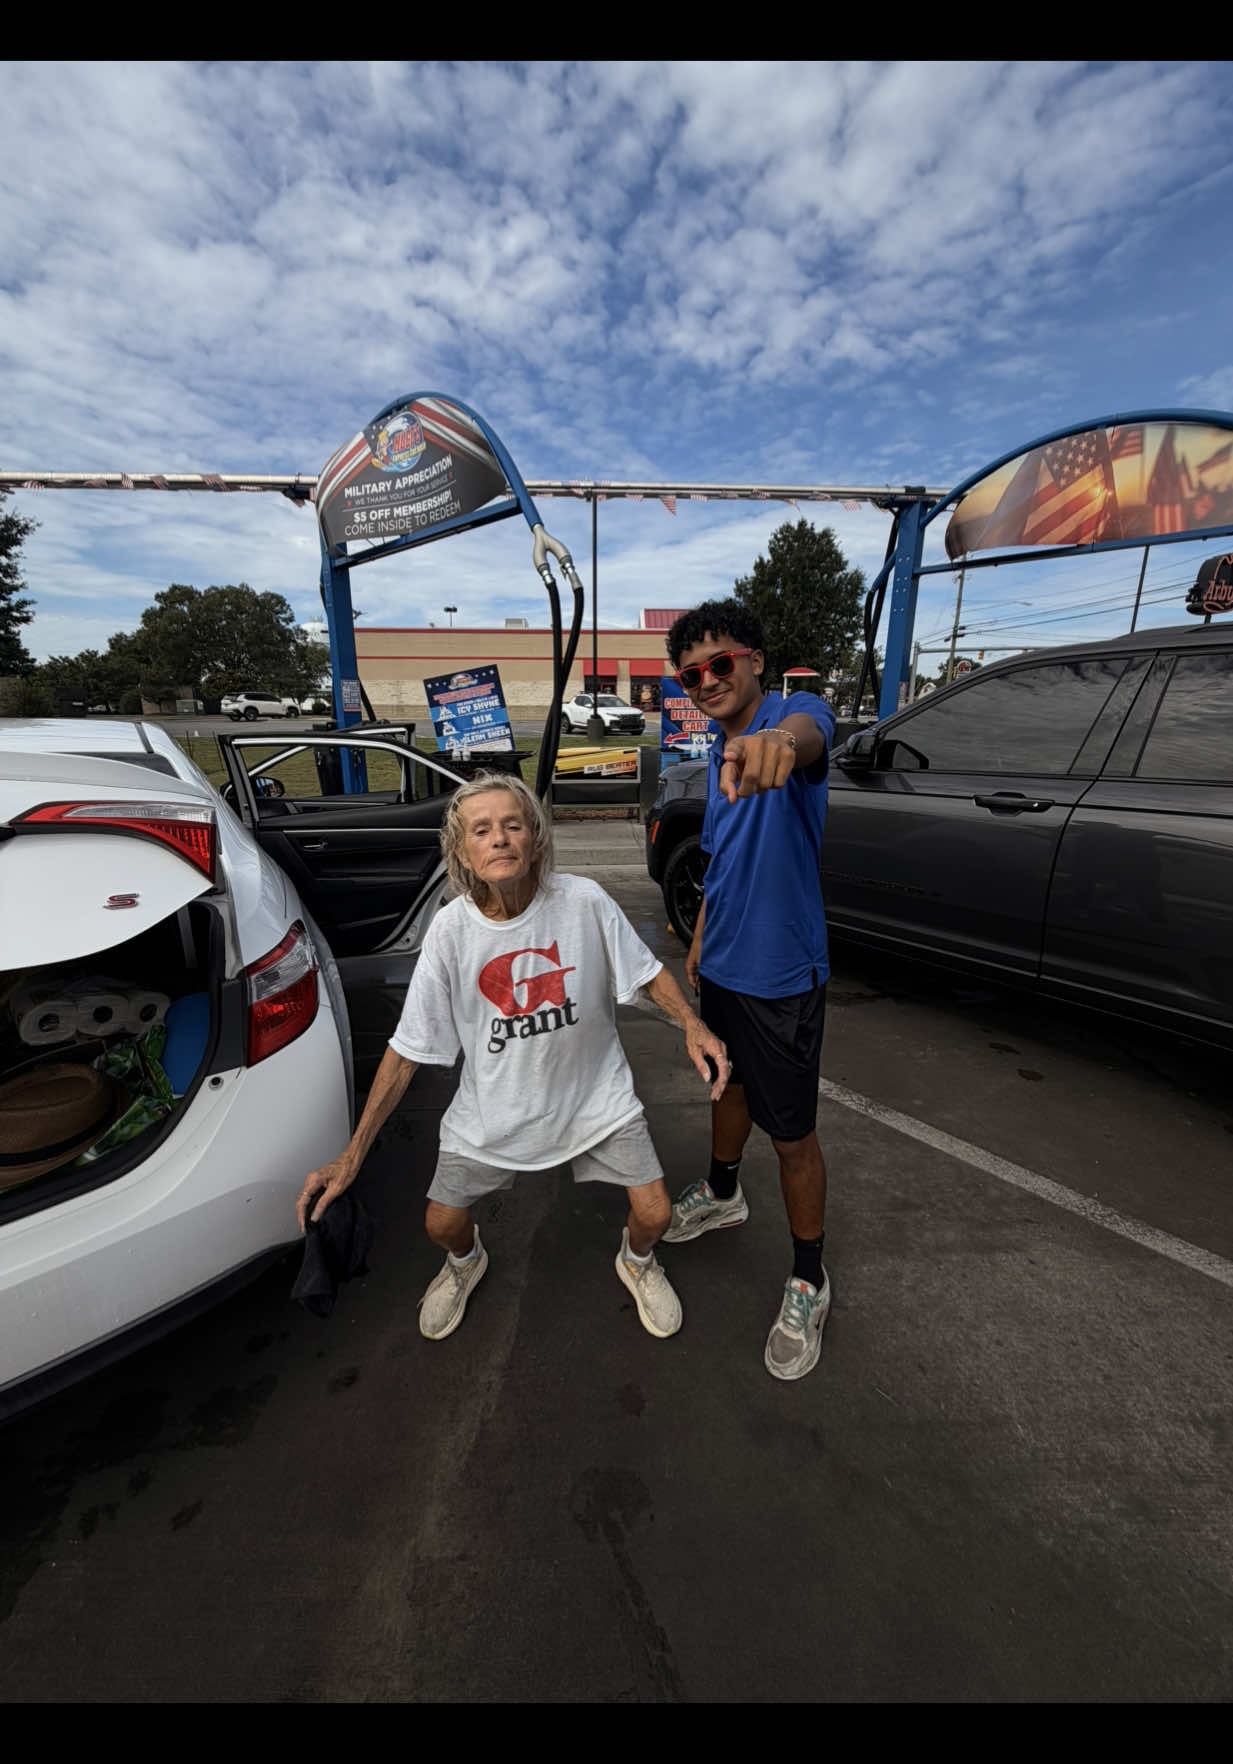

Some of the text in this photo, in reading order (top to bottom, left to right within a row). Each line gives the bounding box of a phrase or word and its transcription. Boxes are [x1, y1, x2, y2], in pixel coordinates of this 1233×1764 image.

[344, 454, 453, 498] MILITARY APPRECIATION
[367, 495, 388, 504] THANK
[390, 492, 402, 500] YOU
[403, 490, 416, 498] FOR
[416, 484, 430, 495] YOUR
[431, 475, 448, 490] SERVICE
[344, 499, 461, 536] COME INSIDE TO REDEEM
[353, 488, 453, 523] $5 OFF MEMBERSHIP!
[1203, 579, 1233, 606] Arby
[457, 704, 471, 715] ICY
[682, 720, 709, 731] CART
[103, 893, 139, 910] S
[478, 940, 576, 1017] G
[488, 997, 579, 1054] grant
